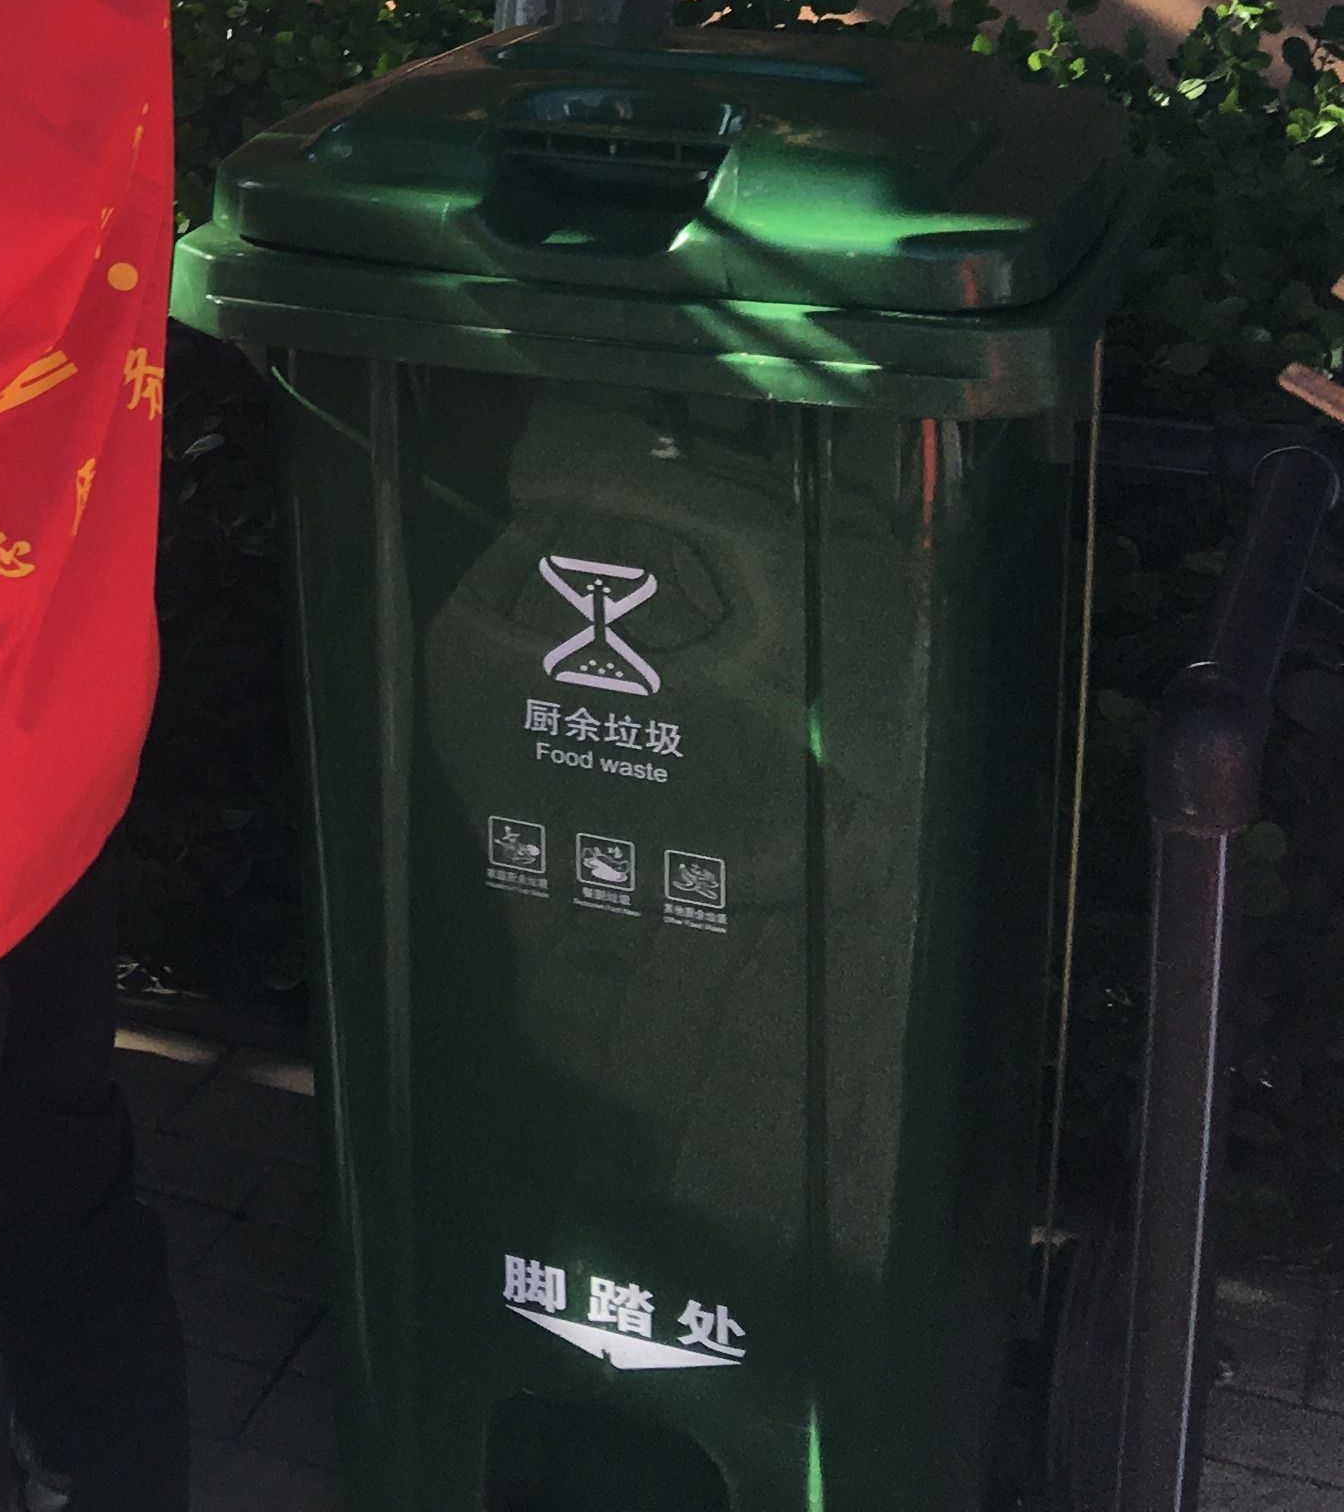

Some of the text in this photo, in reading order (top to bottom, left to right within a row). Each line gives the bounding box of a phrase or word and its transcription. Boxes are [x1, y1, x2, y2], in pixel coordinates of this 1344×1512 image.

[523, 699, 684, 758] 厨余垃圾
[535, 742, 668, 783] Food waste
[503, 1254, 746, 1358] 脚踏处
